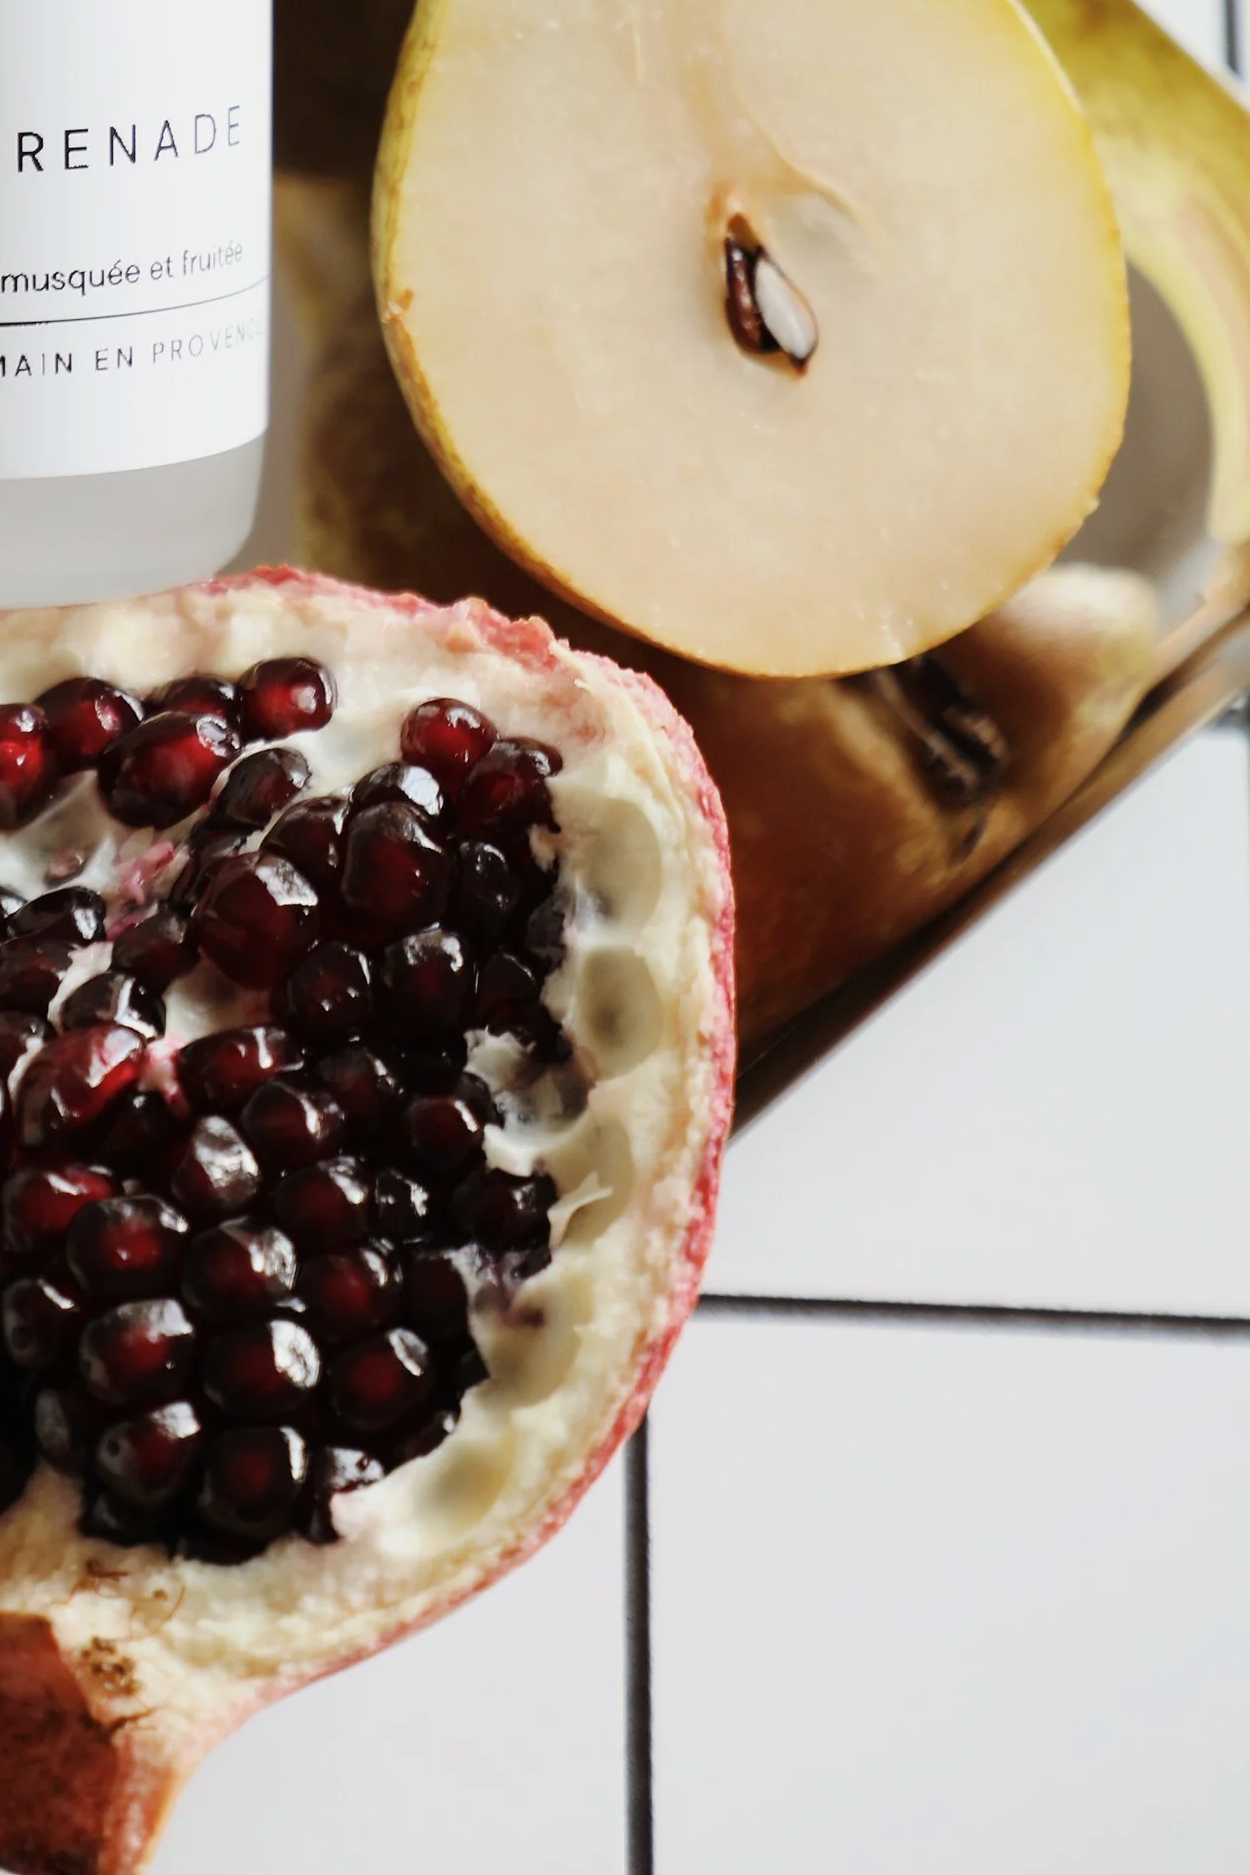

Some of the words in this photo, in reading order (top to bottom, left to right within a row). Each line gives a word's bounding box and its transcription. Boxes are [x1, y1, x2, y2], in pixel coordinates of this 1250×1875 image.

[0, 258, 142, 298] musquée
[148, 255, 174, 281] et
[181, 238, 243, 276] fruitée
[93, 344, 135, 372] EN
